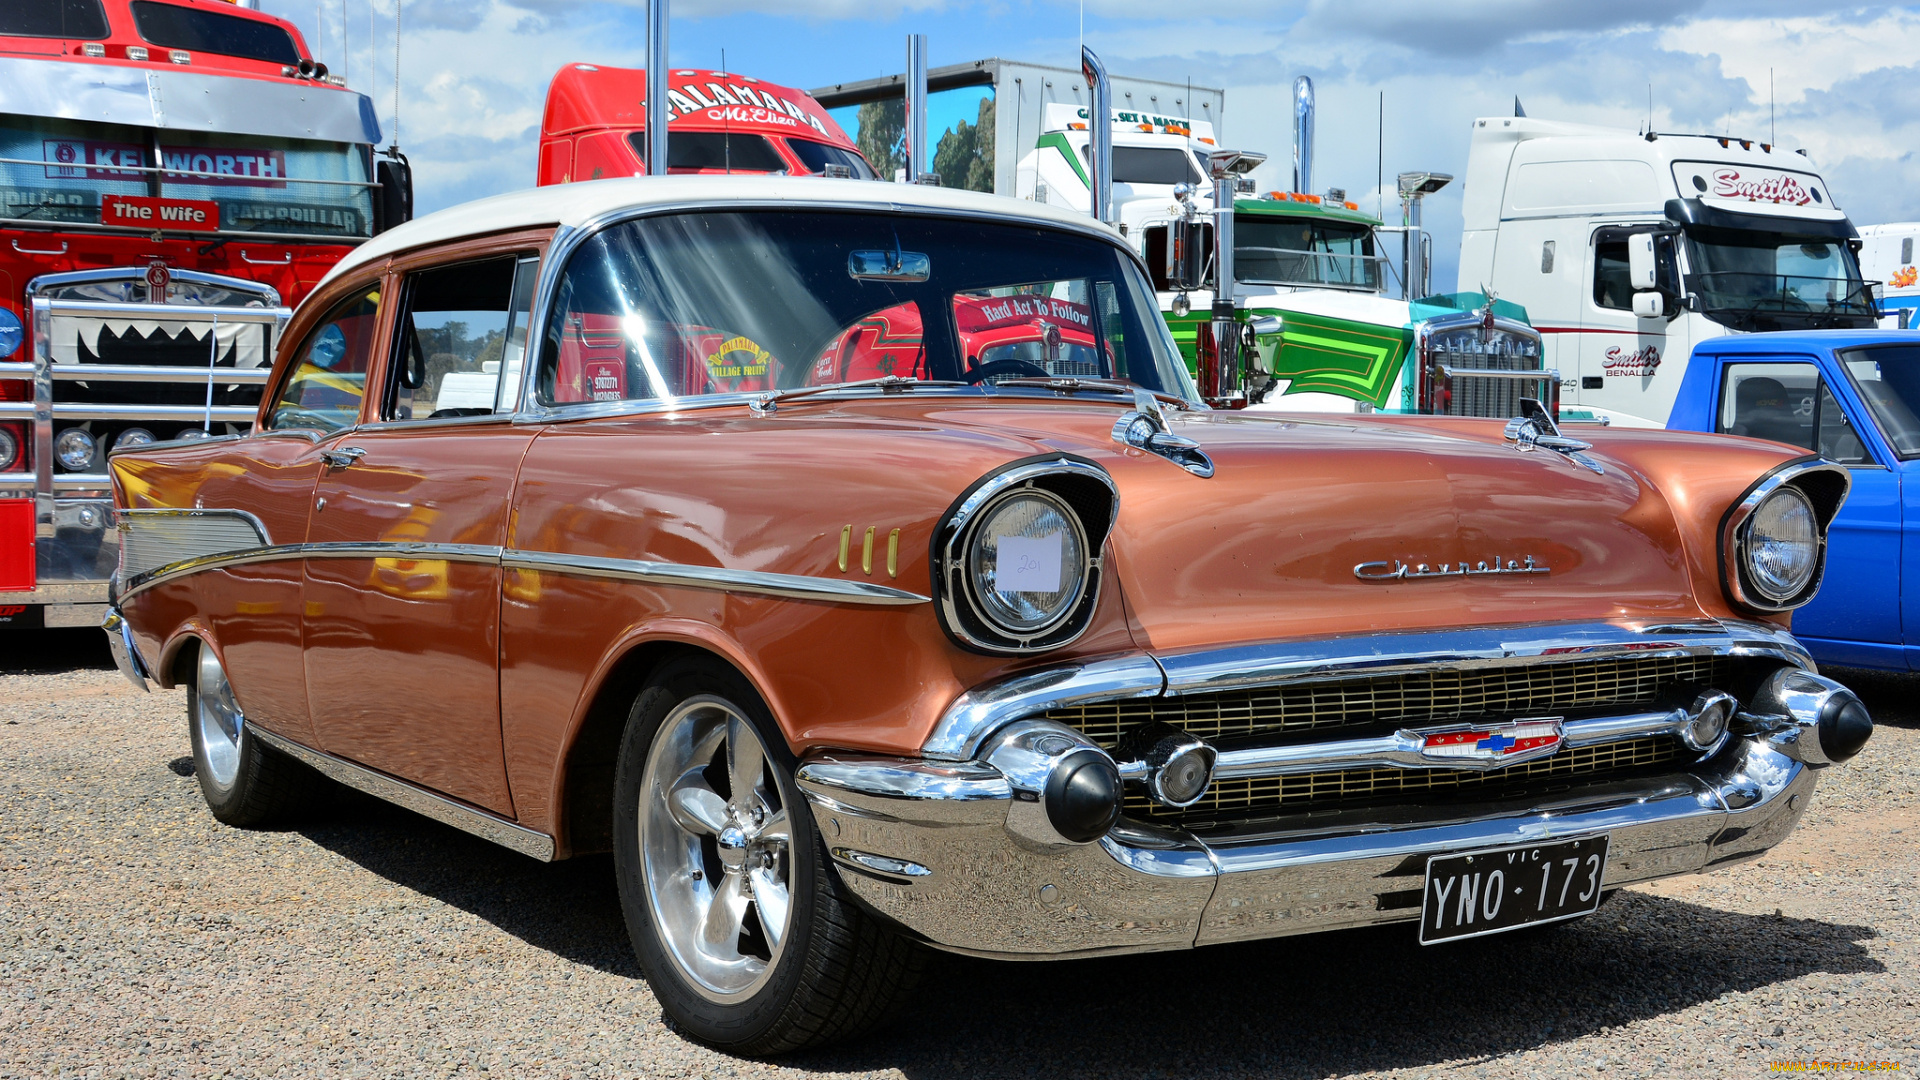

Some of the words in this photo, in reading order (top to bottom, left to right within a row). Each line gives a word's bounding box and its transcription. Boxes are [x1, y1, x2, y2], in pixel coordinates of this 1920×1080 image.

[1118, 112, 1139, 123] SET
[94, 147, 279, 180] KEWORTH
[1713, 168, 1811, 205] Smith's
[112, 203, 153, 220] The
[160, 206, 206, 223] Wife
[981, 301, 1013, 323] Hard
[1012, 299, 1034, 316] Act
[1032, 299, 1049, 316] To
[1050, 301, 1090, 326] Follow
[1602, 345, 1662, 368] Smith's
[711, 366, 742, 377] VILLAGE
[1605, 369, 1656, 377] BENALLA
[1017, 554, 1041, 573] 201
[1353, 554, 1551, 580] Chevrolet
[1507, 849, 1541, 865] VIC
